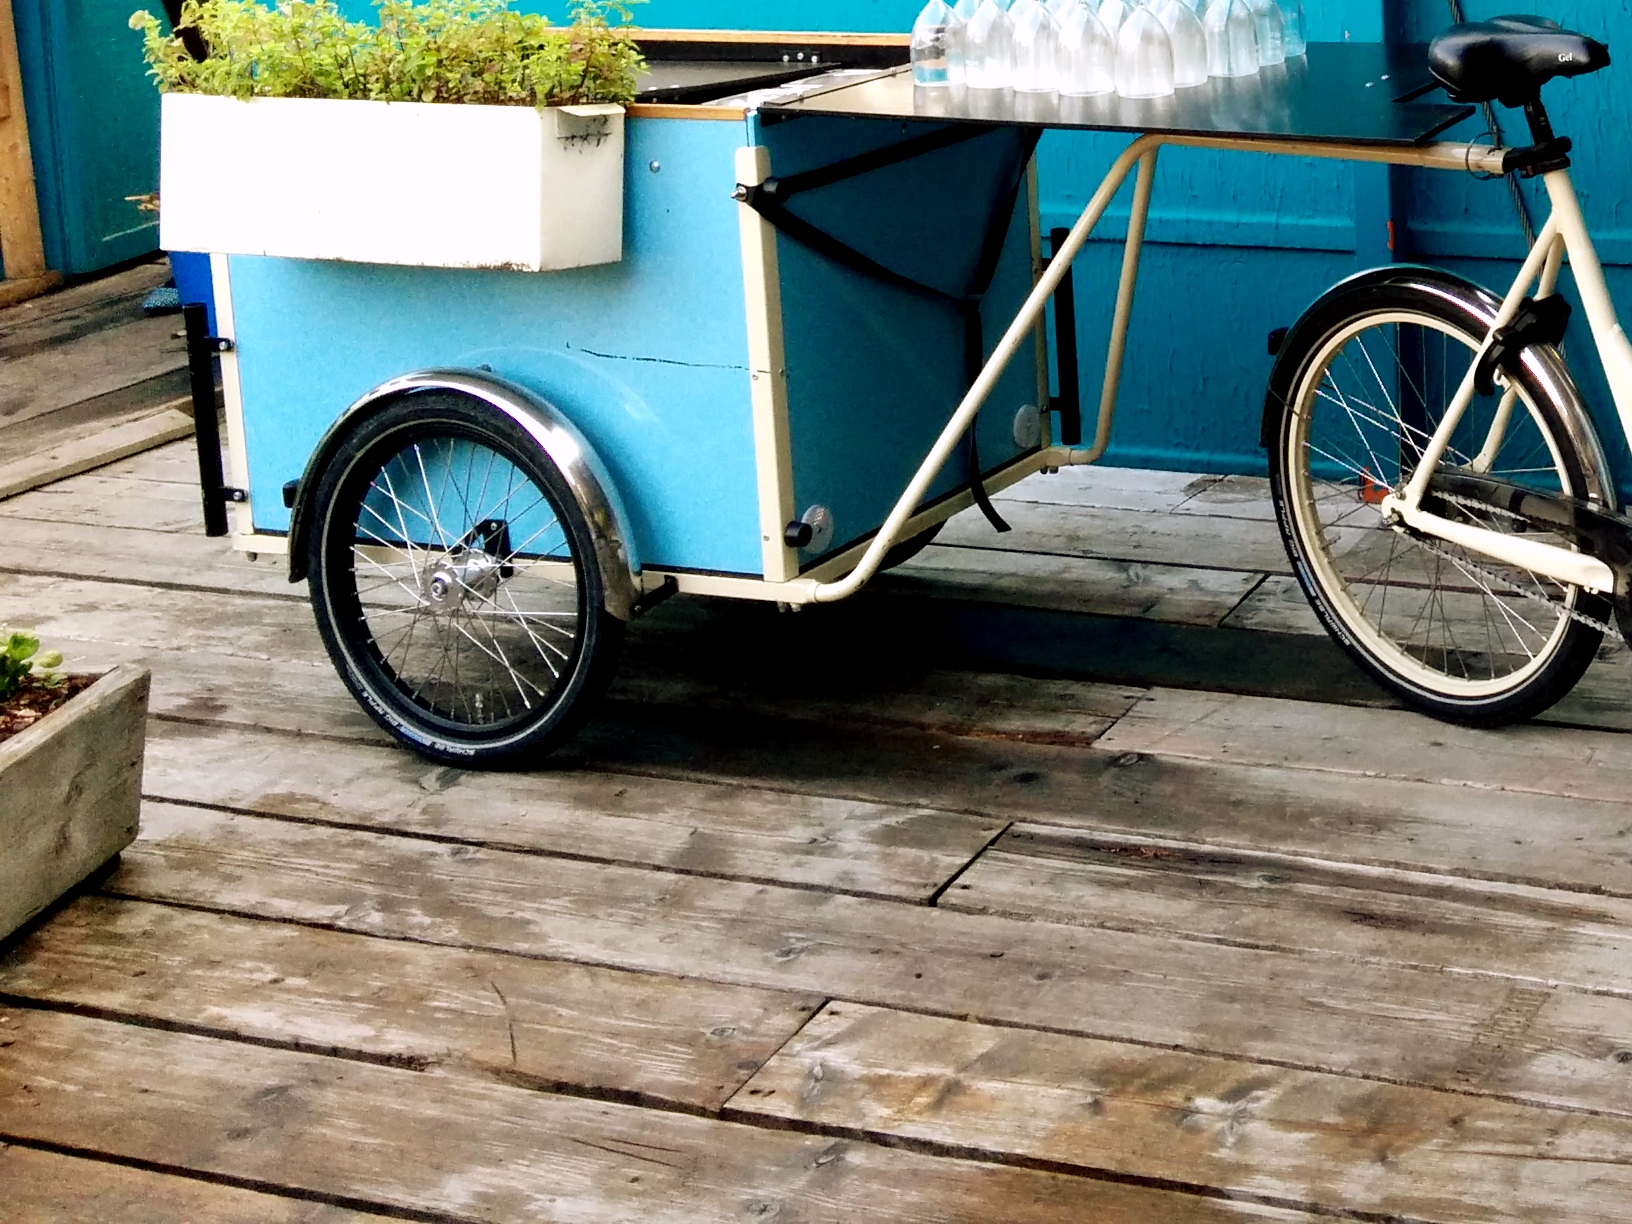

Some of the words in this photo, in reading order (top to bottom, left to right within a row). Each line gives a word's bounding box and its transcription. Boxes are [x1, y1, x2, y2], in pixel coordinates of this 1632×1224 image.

[1558, 52, 1573, 62] Gel
[1279, 500, 1290, 536] APPLE
[1317, 599, 1350, 647] SCHWALBE
[384, 715, 398, 727] BIG
